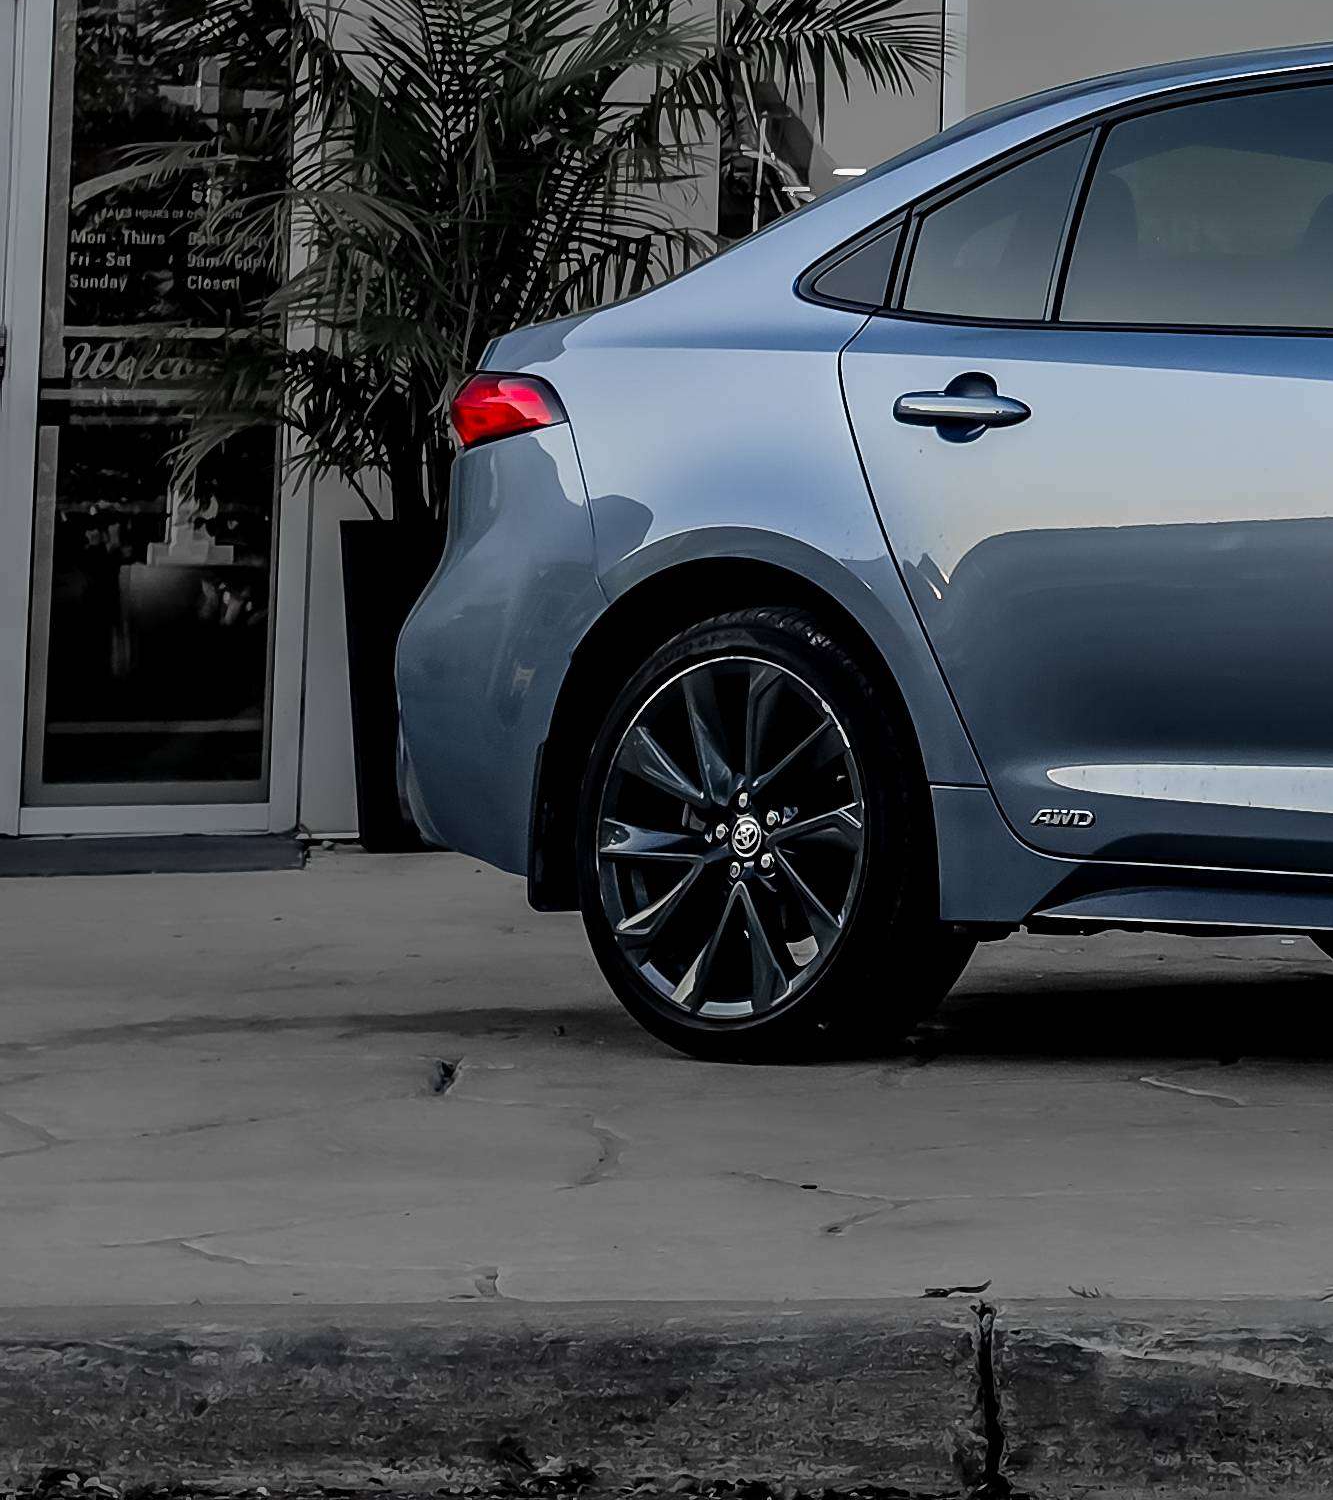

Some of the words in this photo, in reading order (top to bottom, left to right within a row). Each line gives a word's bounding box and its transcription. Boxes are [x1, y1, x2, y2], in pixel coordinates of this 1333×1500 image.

[70, 229, 106, 245] Mon
[121, 228, 167, 245] Thurs
[69, 251, 90, 267] Fri
[105, 251, 131, 267] Sat
[69, 273, 129, 292] Sunday
[187, 274, 240, 291] Closed
[1029, 807, 1095, 828] AWD
